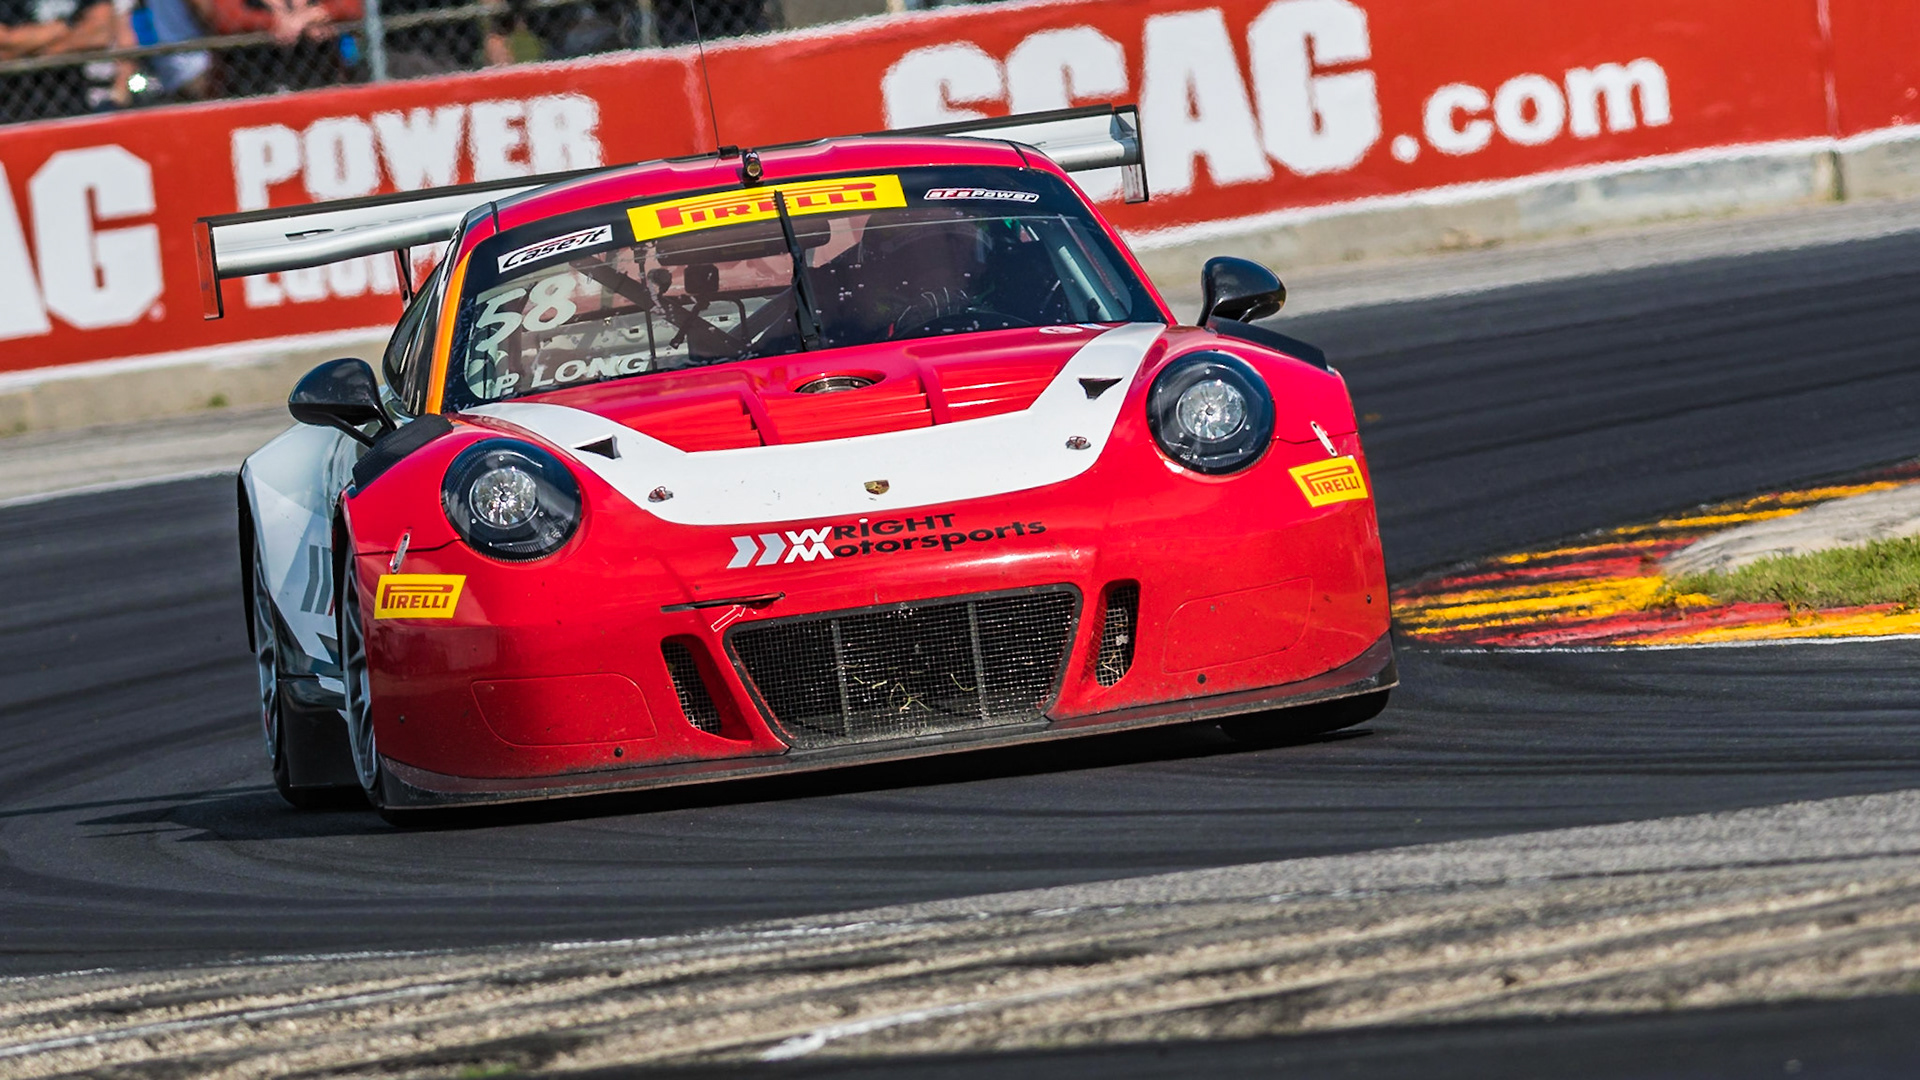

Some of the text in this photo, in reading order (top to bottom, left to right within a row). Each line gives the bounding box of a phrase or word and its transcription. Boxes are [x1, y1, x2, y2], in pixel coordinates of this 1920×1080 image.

[231, 93, 603, 211] POWER
[656, 182, 878, 229] PIRELLI
[475, 272, 577, 351] 58
[531, 352, 651, 388] LONG
[1301, 465, 1361, 496] PIRELLI
[784, 520, 1047, 563] Motorsports
[381, 583, 454, 609] PIRELLI
